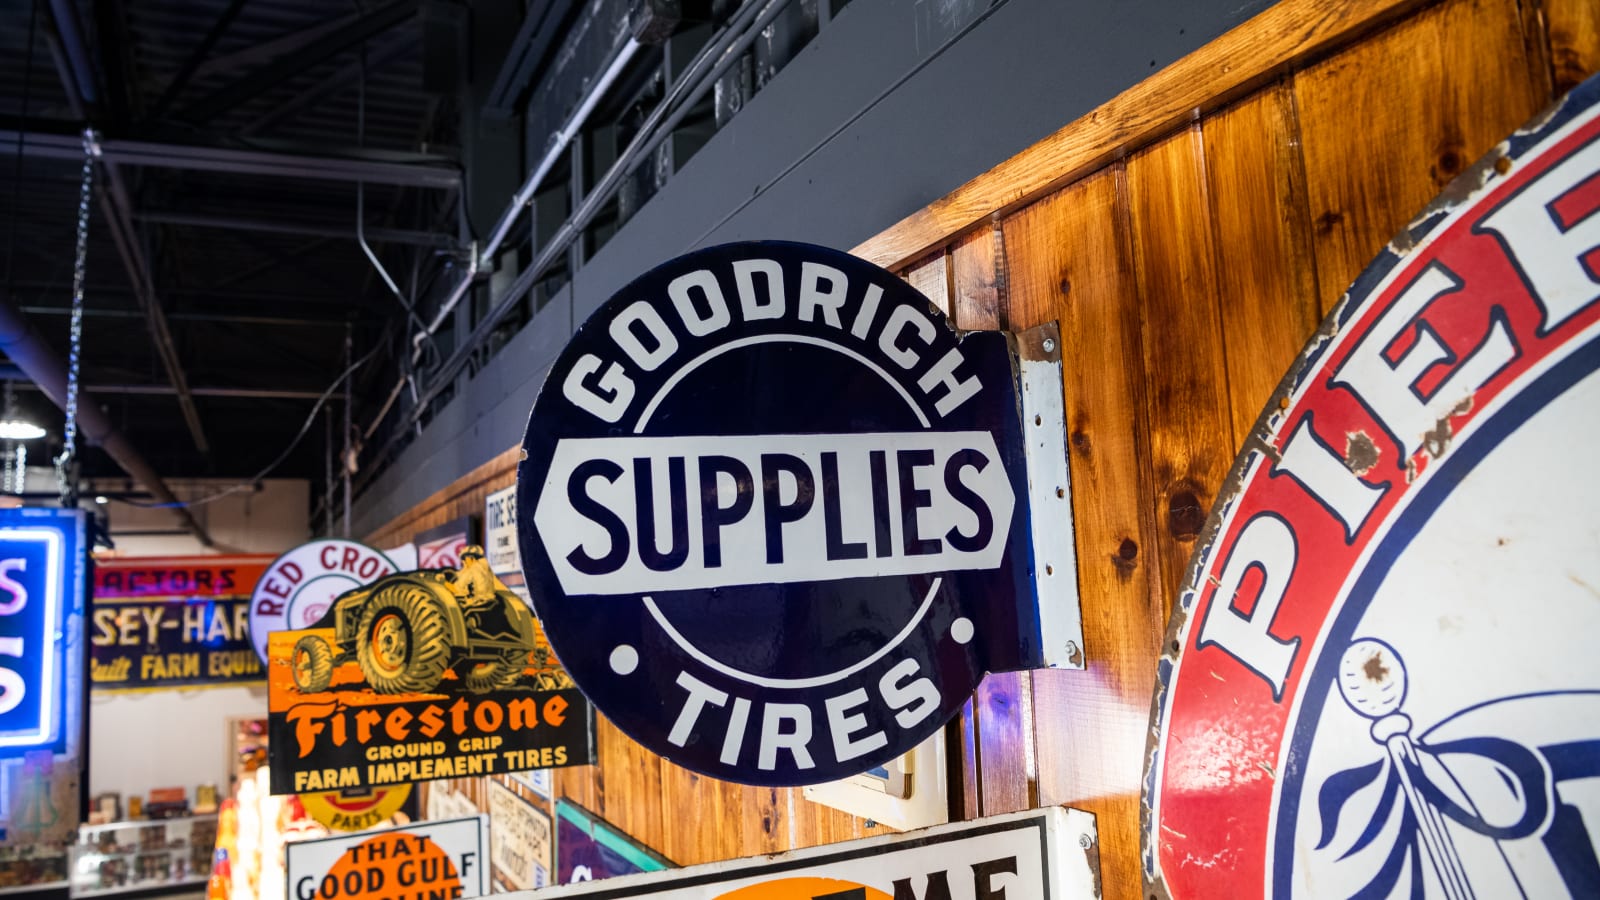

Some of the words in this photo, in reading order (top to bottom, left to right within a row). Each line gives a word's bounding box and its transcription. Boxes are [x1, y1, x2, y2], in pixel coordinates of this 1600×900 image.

[562, 259, 983, 423] GOODRICH
[566, 448, 994, 576] SUPPLIES
[103, 569, 236, 593] ACTORS
[256, 561, 304, 617] RED
[141, 653, 200, 680] FARM
[286, 695, 569, 759] Firestone
[666, 656, 942, 771] TIRES
[295, 767, 360, 791] FARM
[368, 754, 498, 784] IMPLEMENT
[504, 747, 568, 770] TIRES
[366, 741, 446, 761] GROUND
[458, 736, 503, 752] GRIP
[331, 807, 383, 828] PARTS
[347, 834, 431, 863] THAT
[296, 866, 385, 900] GOOD
[397, 852, 475, 888] GULF
